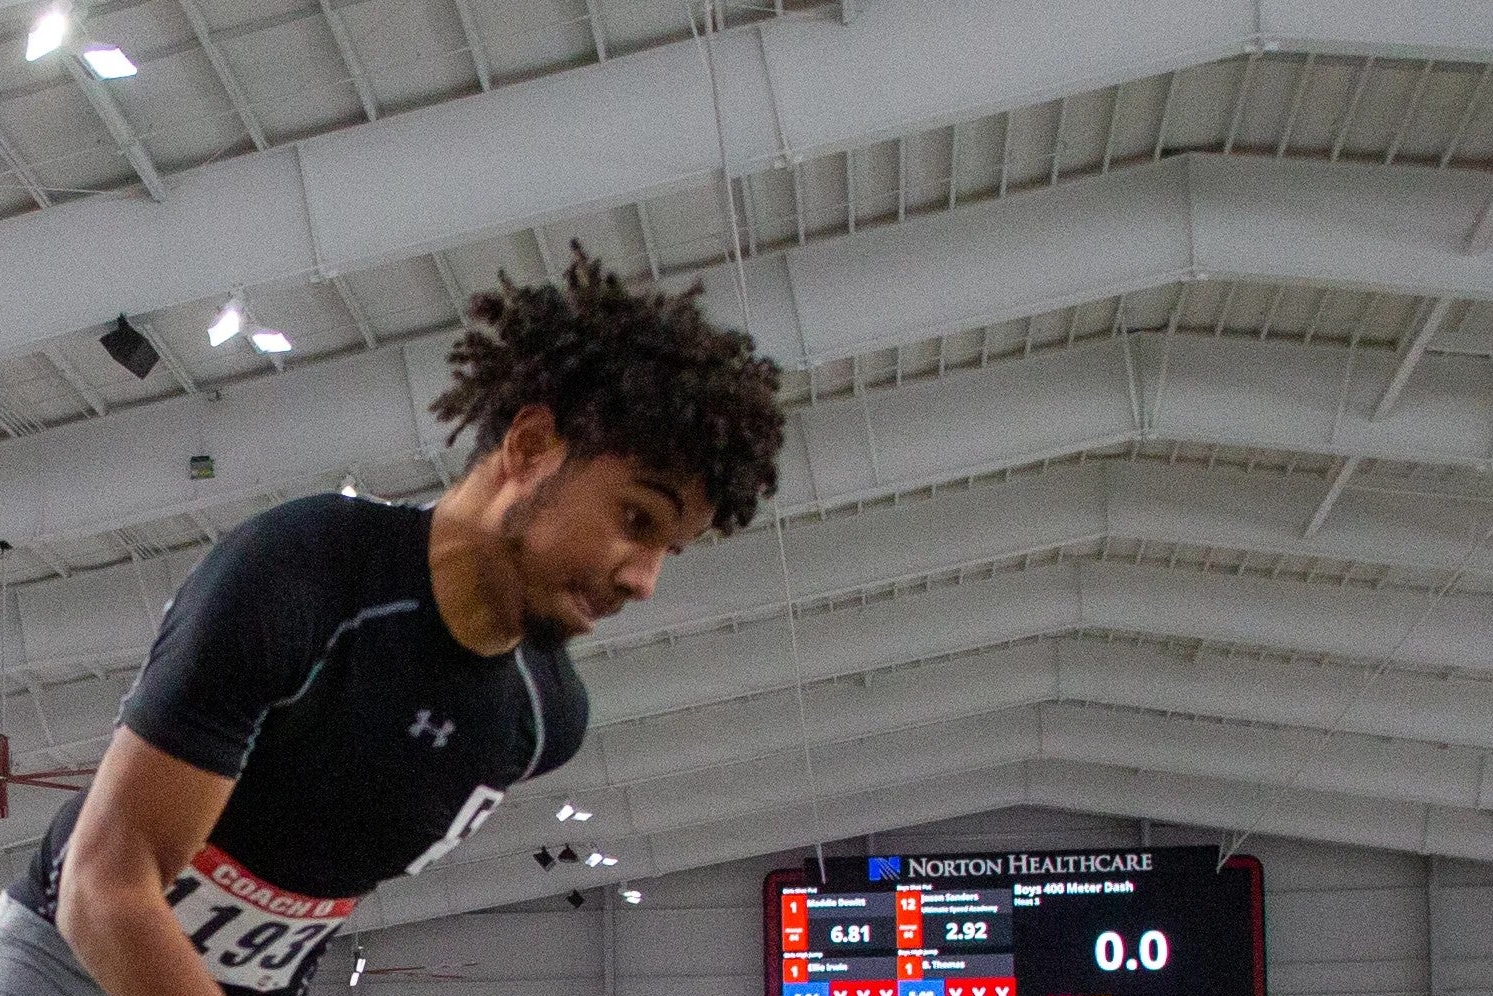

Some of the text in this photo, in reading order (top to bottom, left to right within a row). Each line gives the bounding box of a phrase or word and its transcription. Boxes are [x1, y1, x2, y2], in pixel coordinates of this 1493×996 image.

[908, 853, 1153, 878] NORTON HEALTHCARE
[212, 864, 311, 917] COACH
[1014, 880, 1134, 897] Boys 400 Meter Dash
[790, 901, 797, 914] 1
[901, 898, 916, 911] 12
[831, 924, 870, 943] 6.81
[946, 921, 988, 940] 2.92
[1094, 930, 1169, 972] 0.0
[791, 966, 798, 978] 1
[905, 963, 912, 975] 1
